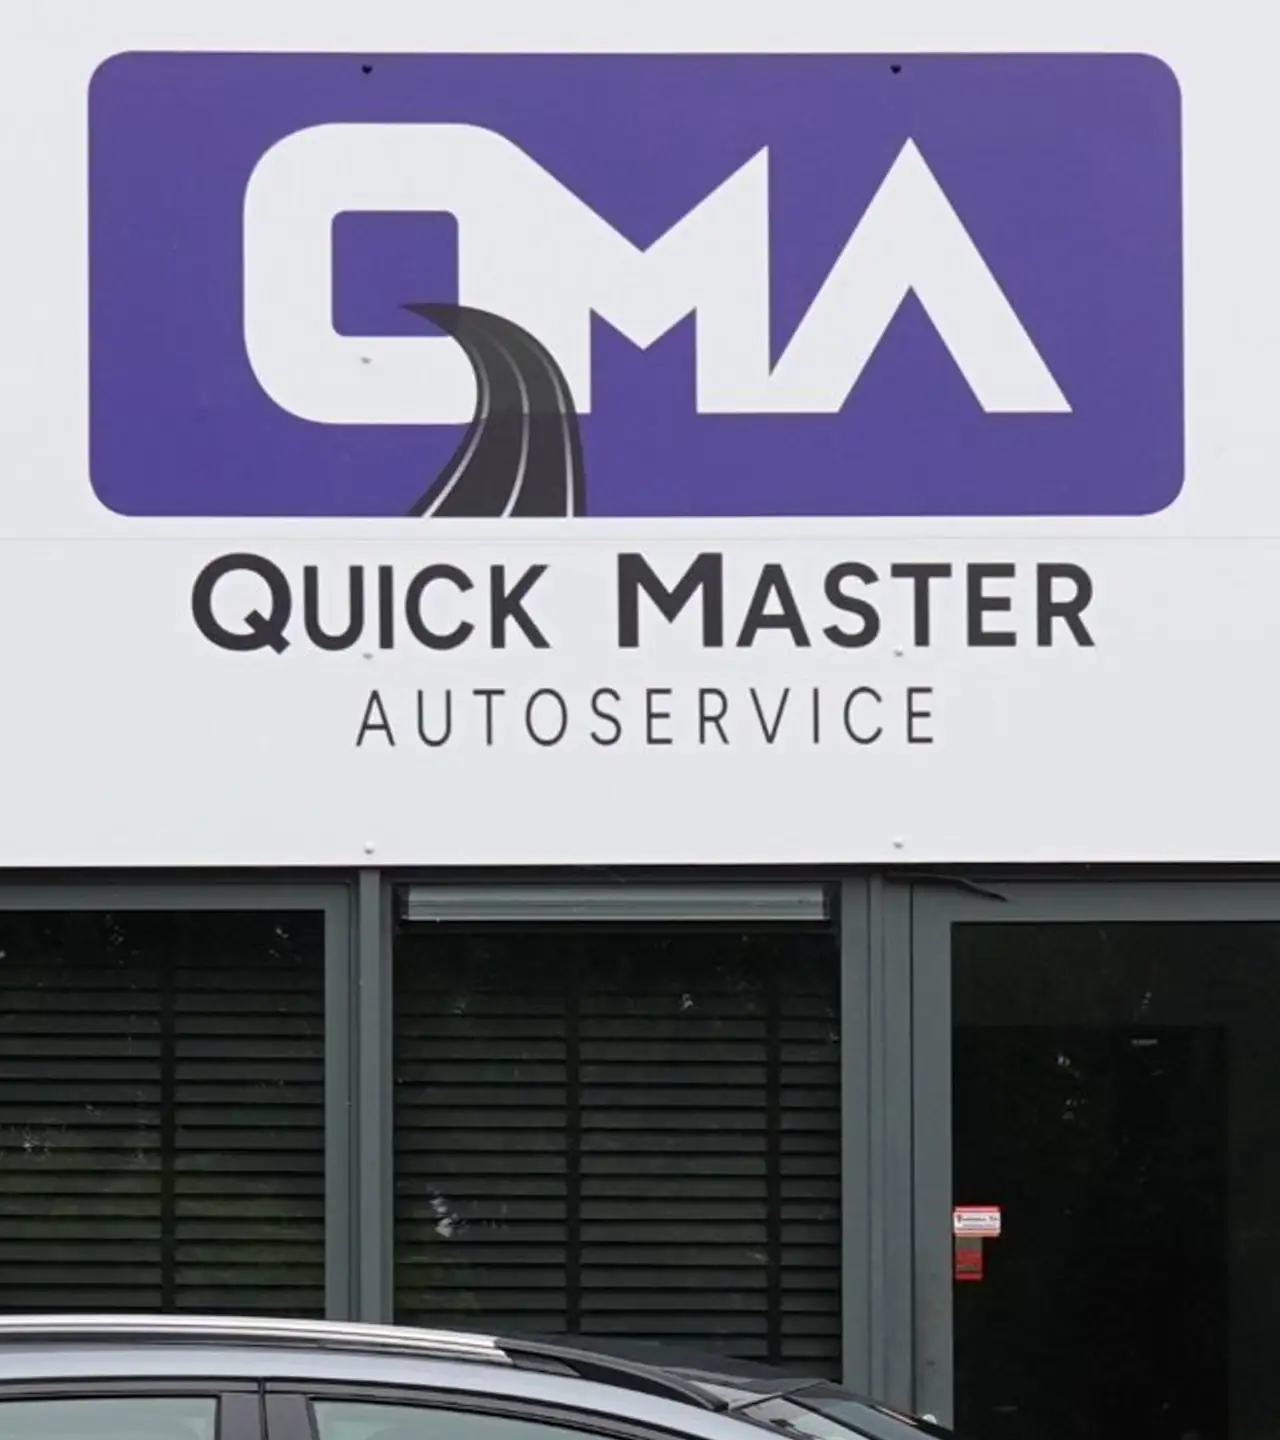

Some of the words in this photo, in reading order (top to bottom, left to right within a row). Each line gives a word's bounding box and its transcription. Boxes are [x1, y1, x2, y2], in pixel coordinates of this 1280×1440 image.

[243, 123, 1073, 424] QMA
[191, 552, 549, 655] QUICK
[617, 552, 1096, 649] MASTER
[356, 686, 934, 748] AUTOSERVICE
